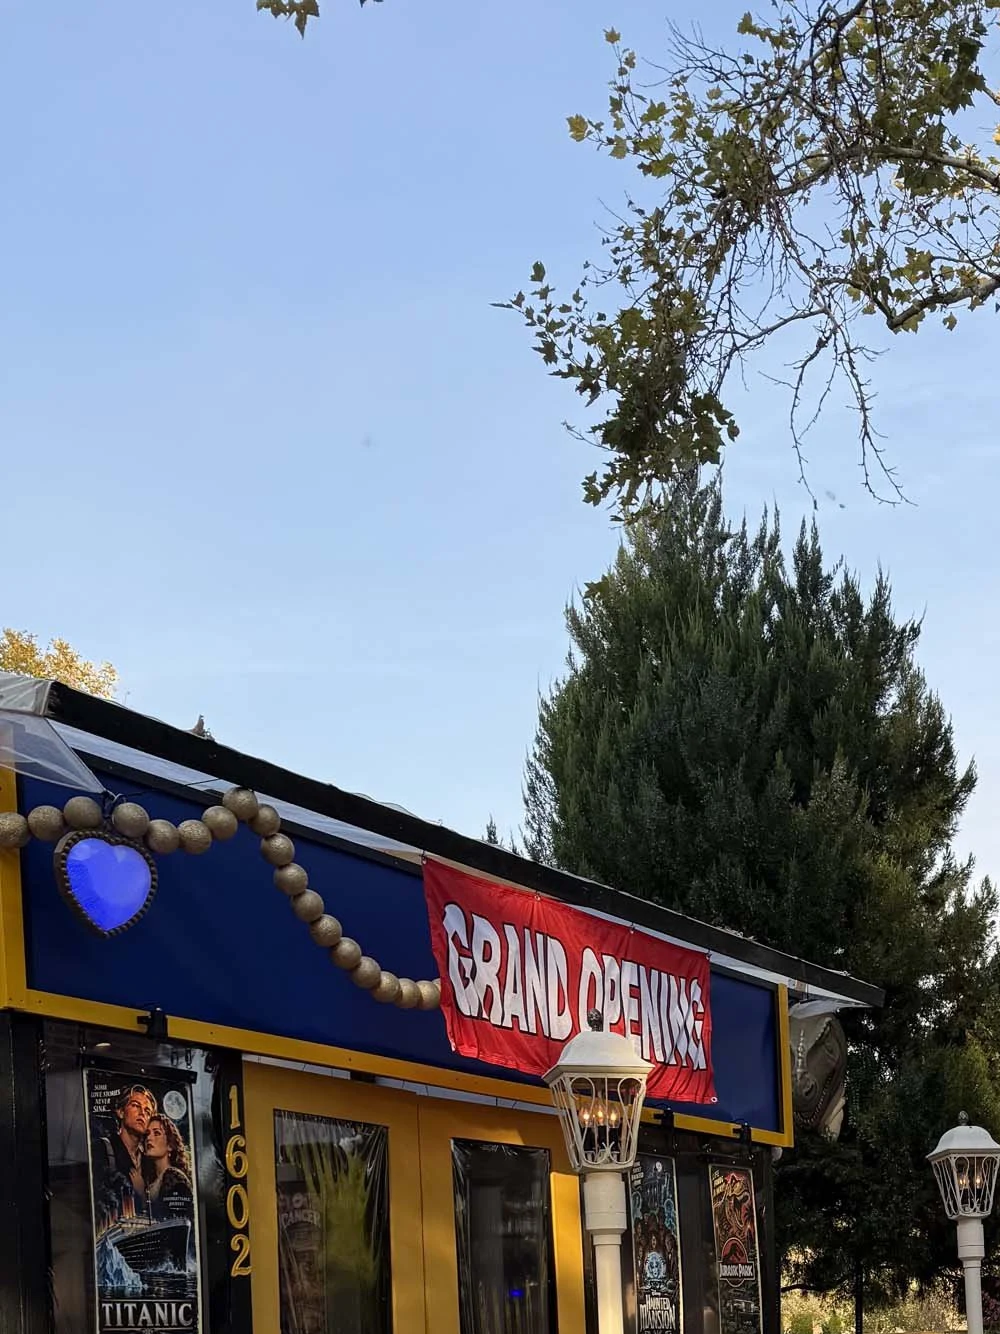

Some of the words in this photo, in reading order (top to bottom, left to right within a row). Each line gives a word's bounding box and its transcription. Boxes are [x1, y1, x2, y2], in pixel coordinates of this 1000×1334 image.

[443, 904, 573, 1041] GRAND
[579, 947, 706, 1070] OPENING
[226, 1085, 252, 1277] 1602
[739, 1264, 753, 1277] PARK
[101, 1303, 193, 1327] TITANIC
[645, 1294, 671, 1312] HAUNTED
[640, 1304, 676, 1330] MANSION
